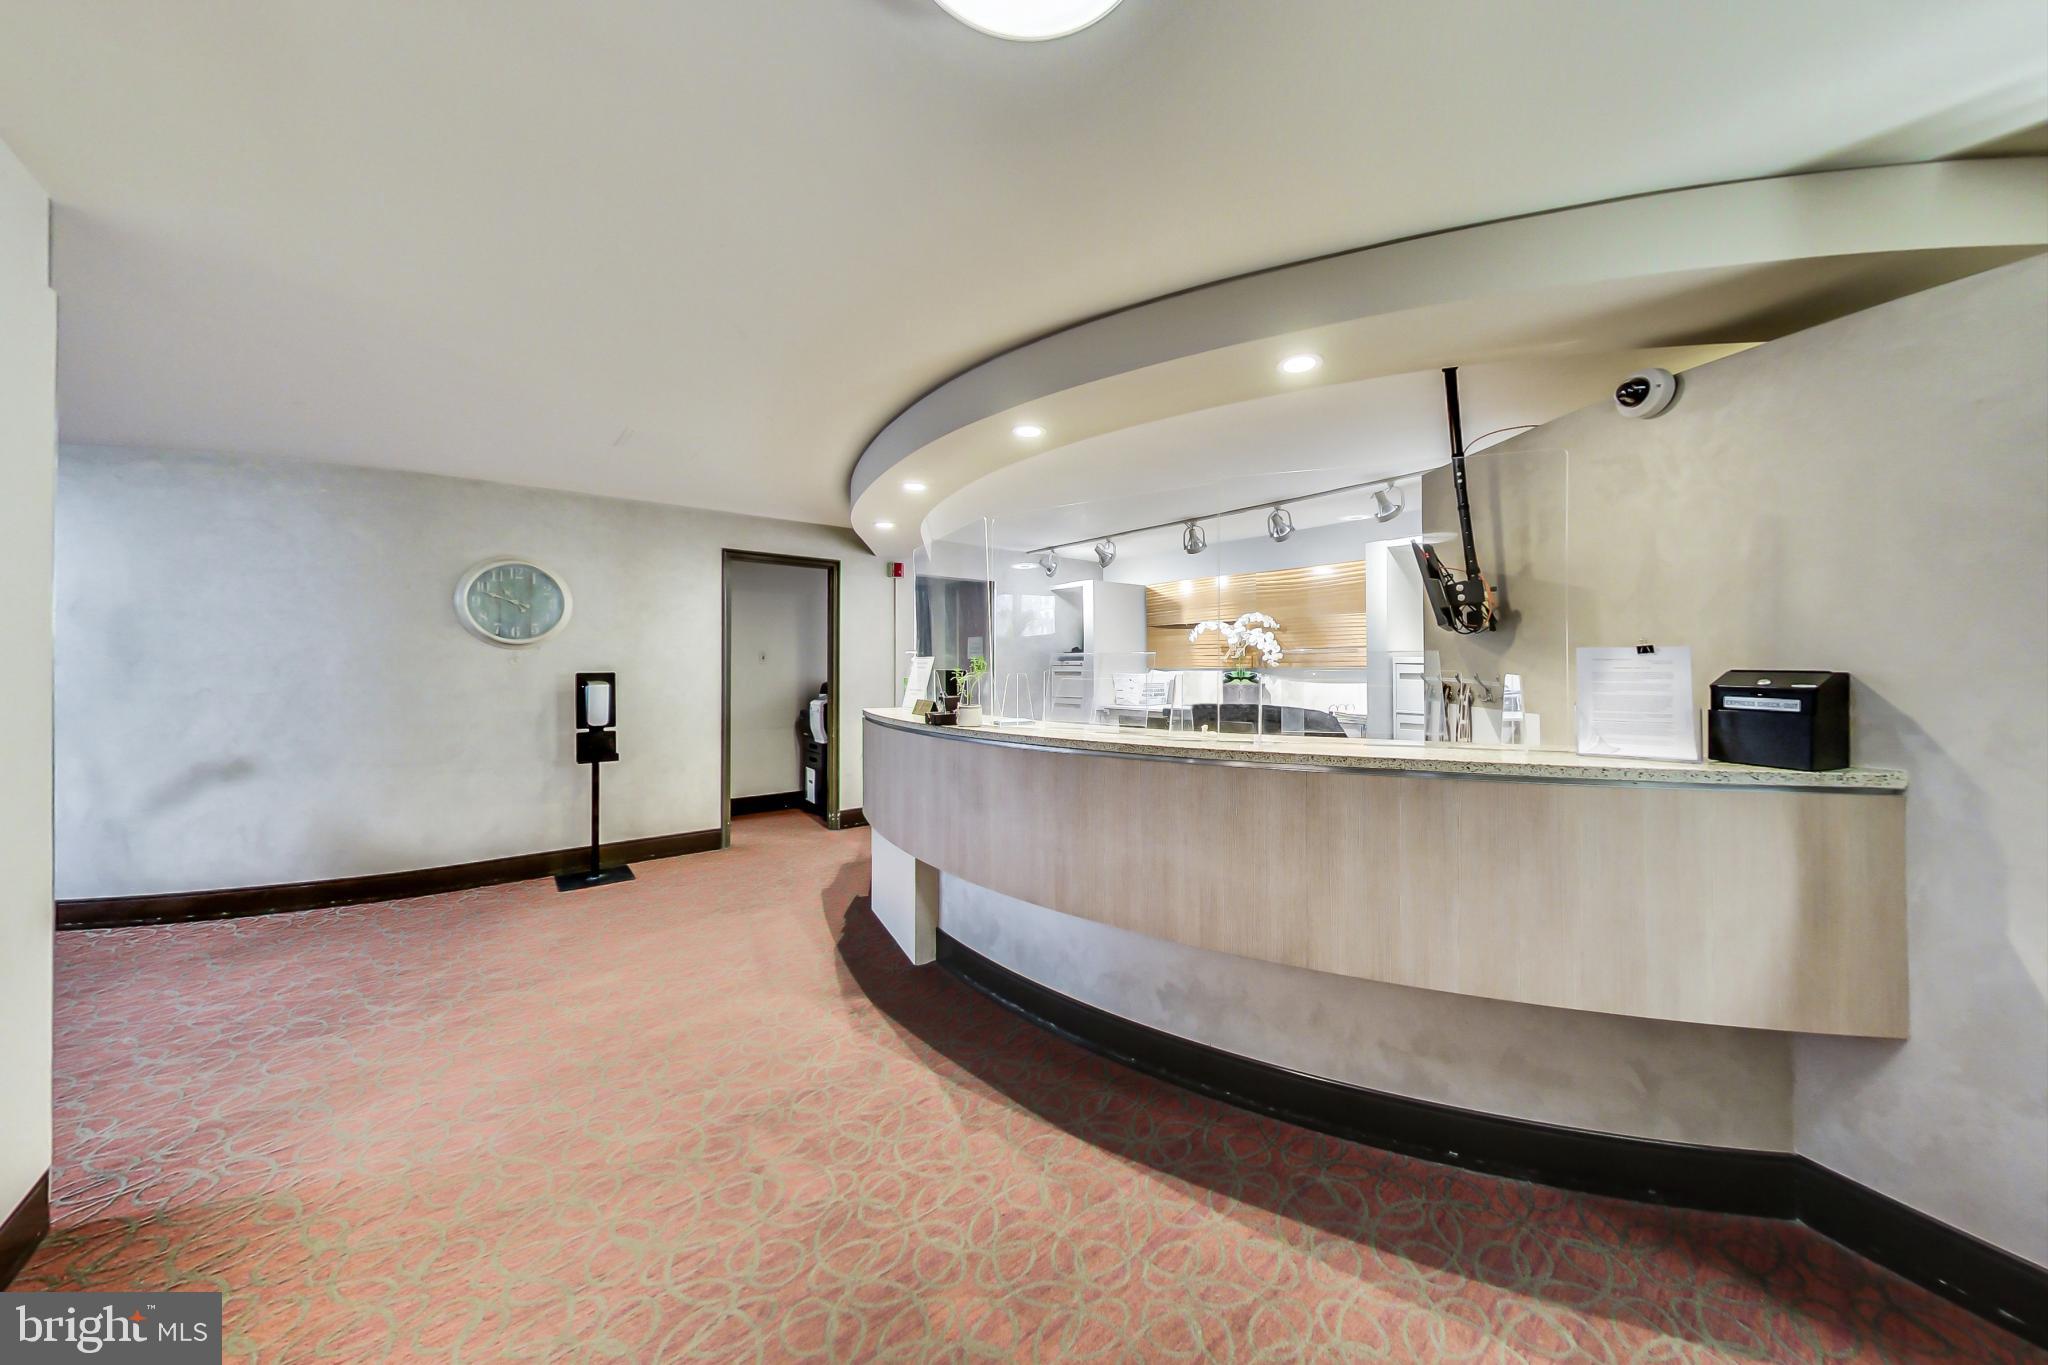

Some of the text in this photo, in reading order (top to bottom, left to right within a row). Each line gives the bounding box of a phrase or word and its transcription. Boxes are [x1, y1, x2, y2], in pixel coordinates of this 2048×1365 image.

[491, 570, 503, 582] 11
[510, 567, 524, 580] 12
[532, 572, 536, 585] 1
[477, 581, 490, 592] 10
[543, 585, 552, 596] 2
[494, 623, 502, 635] 7
[511, 626, 520, 638] 6
